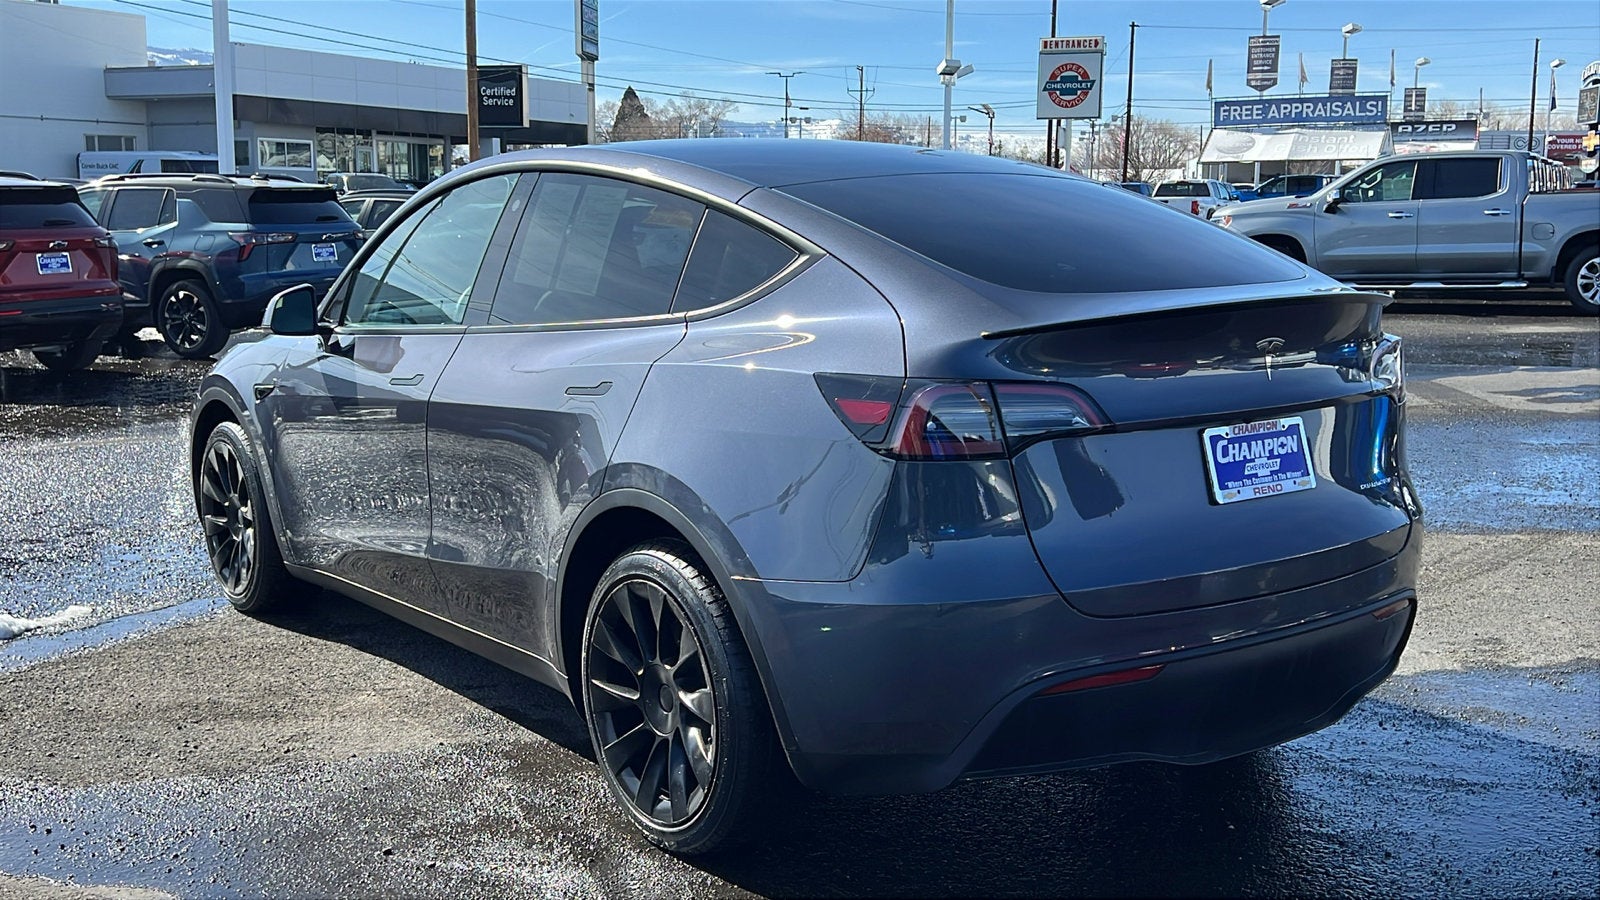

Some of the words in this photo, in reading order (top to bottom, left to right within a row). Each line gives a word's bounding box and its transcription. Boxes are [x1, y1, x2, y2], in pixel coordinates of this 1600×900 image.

[1049, 39, 1093, 49] ENTRANCE
[1054, 64, 1084, 76] SUPER
[480, 86, 516, 96] Certified
[482, 96, 514, 106] Service
[1050, 92, 1086, 108] SERVICE
[1220, 104, 1263, 121] FREE
[1267, 100, 1383, 119] APPRAISALS!
[1274, 143, 1318, 154] Csh
[1232, 420, 1278, 436] CHAMPION
[1216, 435, 1298, 464] CHAMPION
[1246, 460, 1278, 472] CHEVROLET
[1253, 483, 1283, 496] RENO
